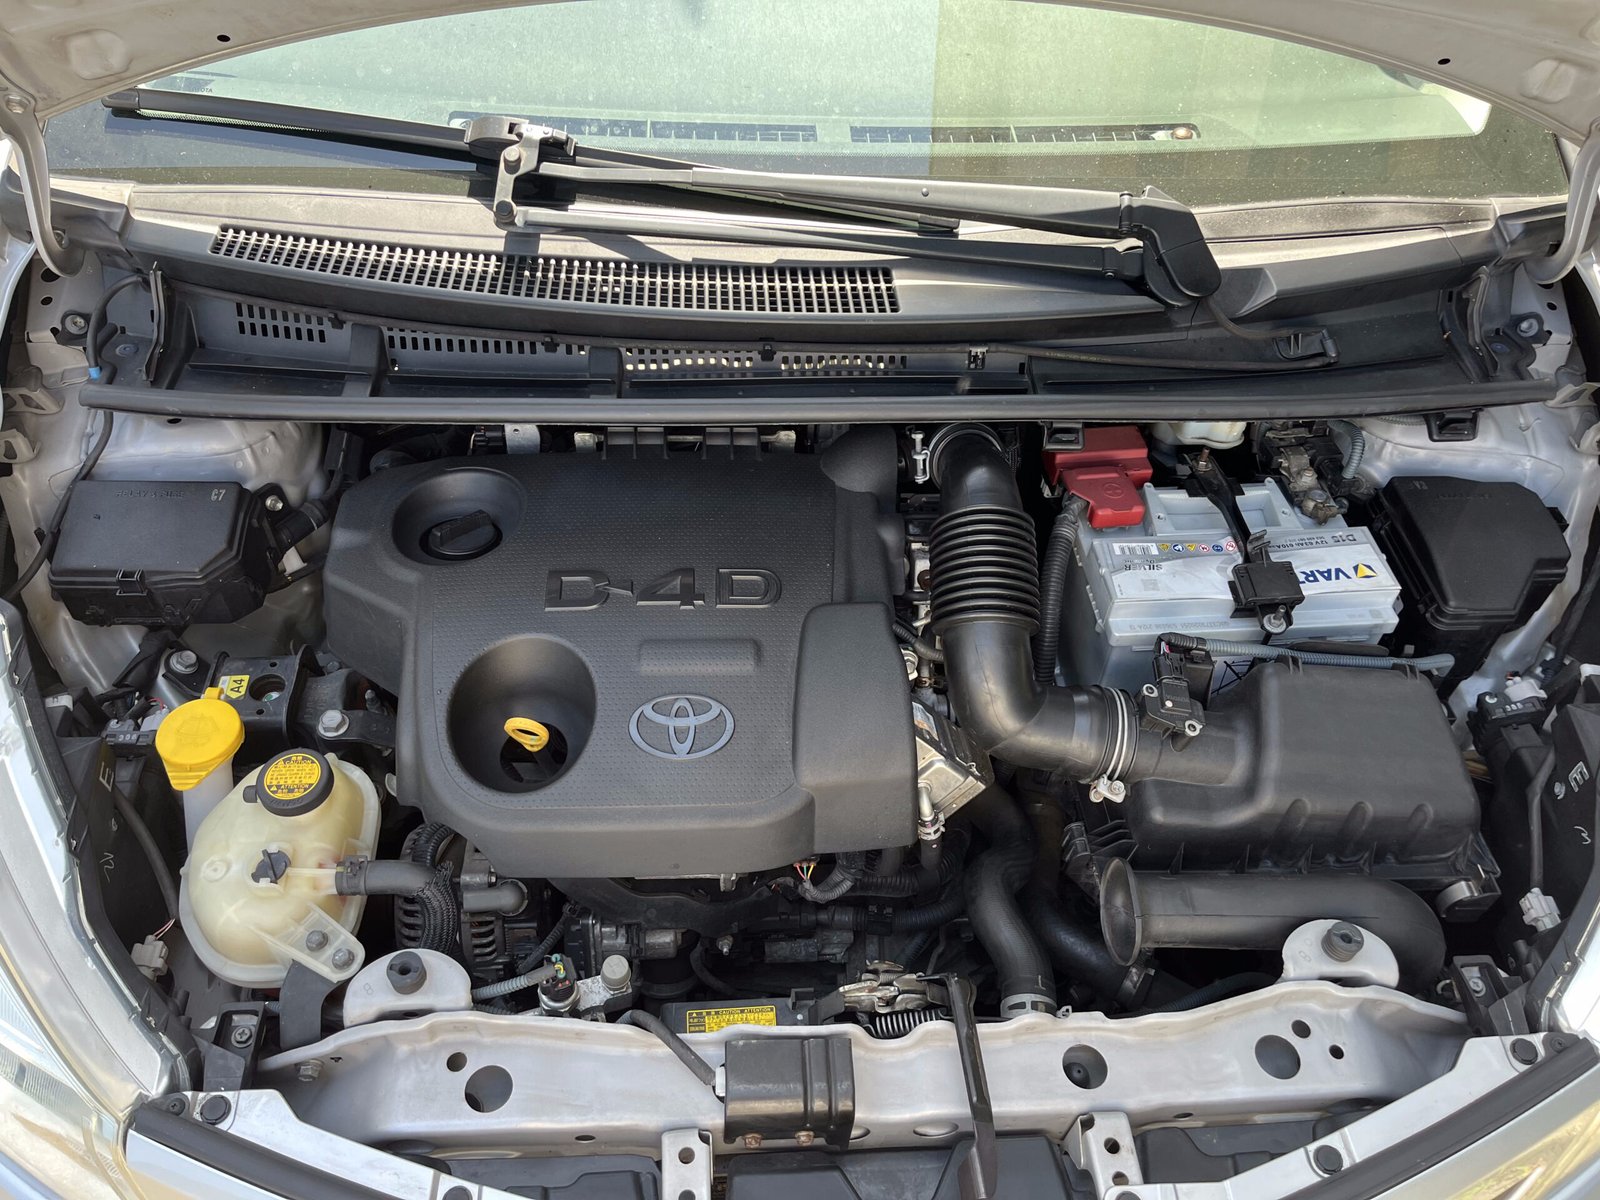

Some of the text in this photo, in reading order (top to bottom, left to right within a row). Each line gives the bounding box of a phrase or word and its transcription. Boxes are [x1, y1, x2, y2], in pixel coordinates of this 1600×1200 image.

[1331, 534, 1357, 543] D15
[1124, 563, 1163, 571] SILVER
[544, 568, 782, 611] D-4D
[230, 678, 245, 693] A4
